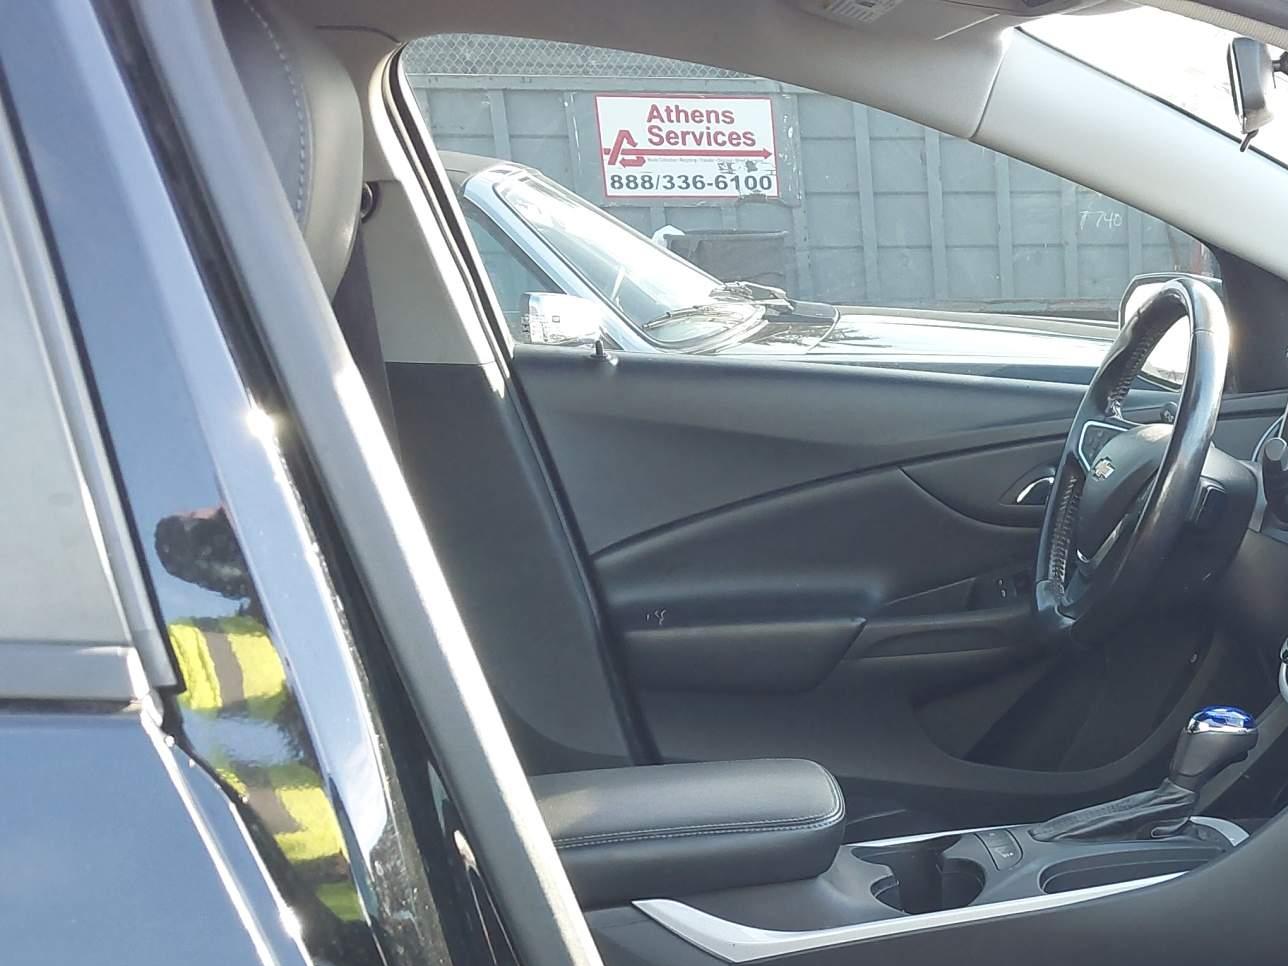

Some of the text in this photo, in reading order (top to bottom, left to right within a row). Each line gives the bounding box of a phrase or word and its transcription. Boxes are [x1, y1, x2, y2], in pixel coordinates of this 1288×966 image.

[647, 104, 734, 124] Athens
[648, 125, 756, 147] Services
[610, 175, 772, 190] 888/336-6100
